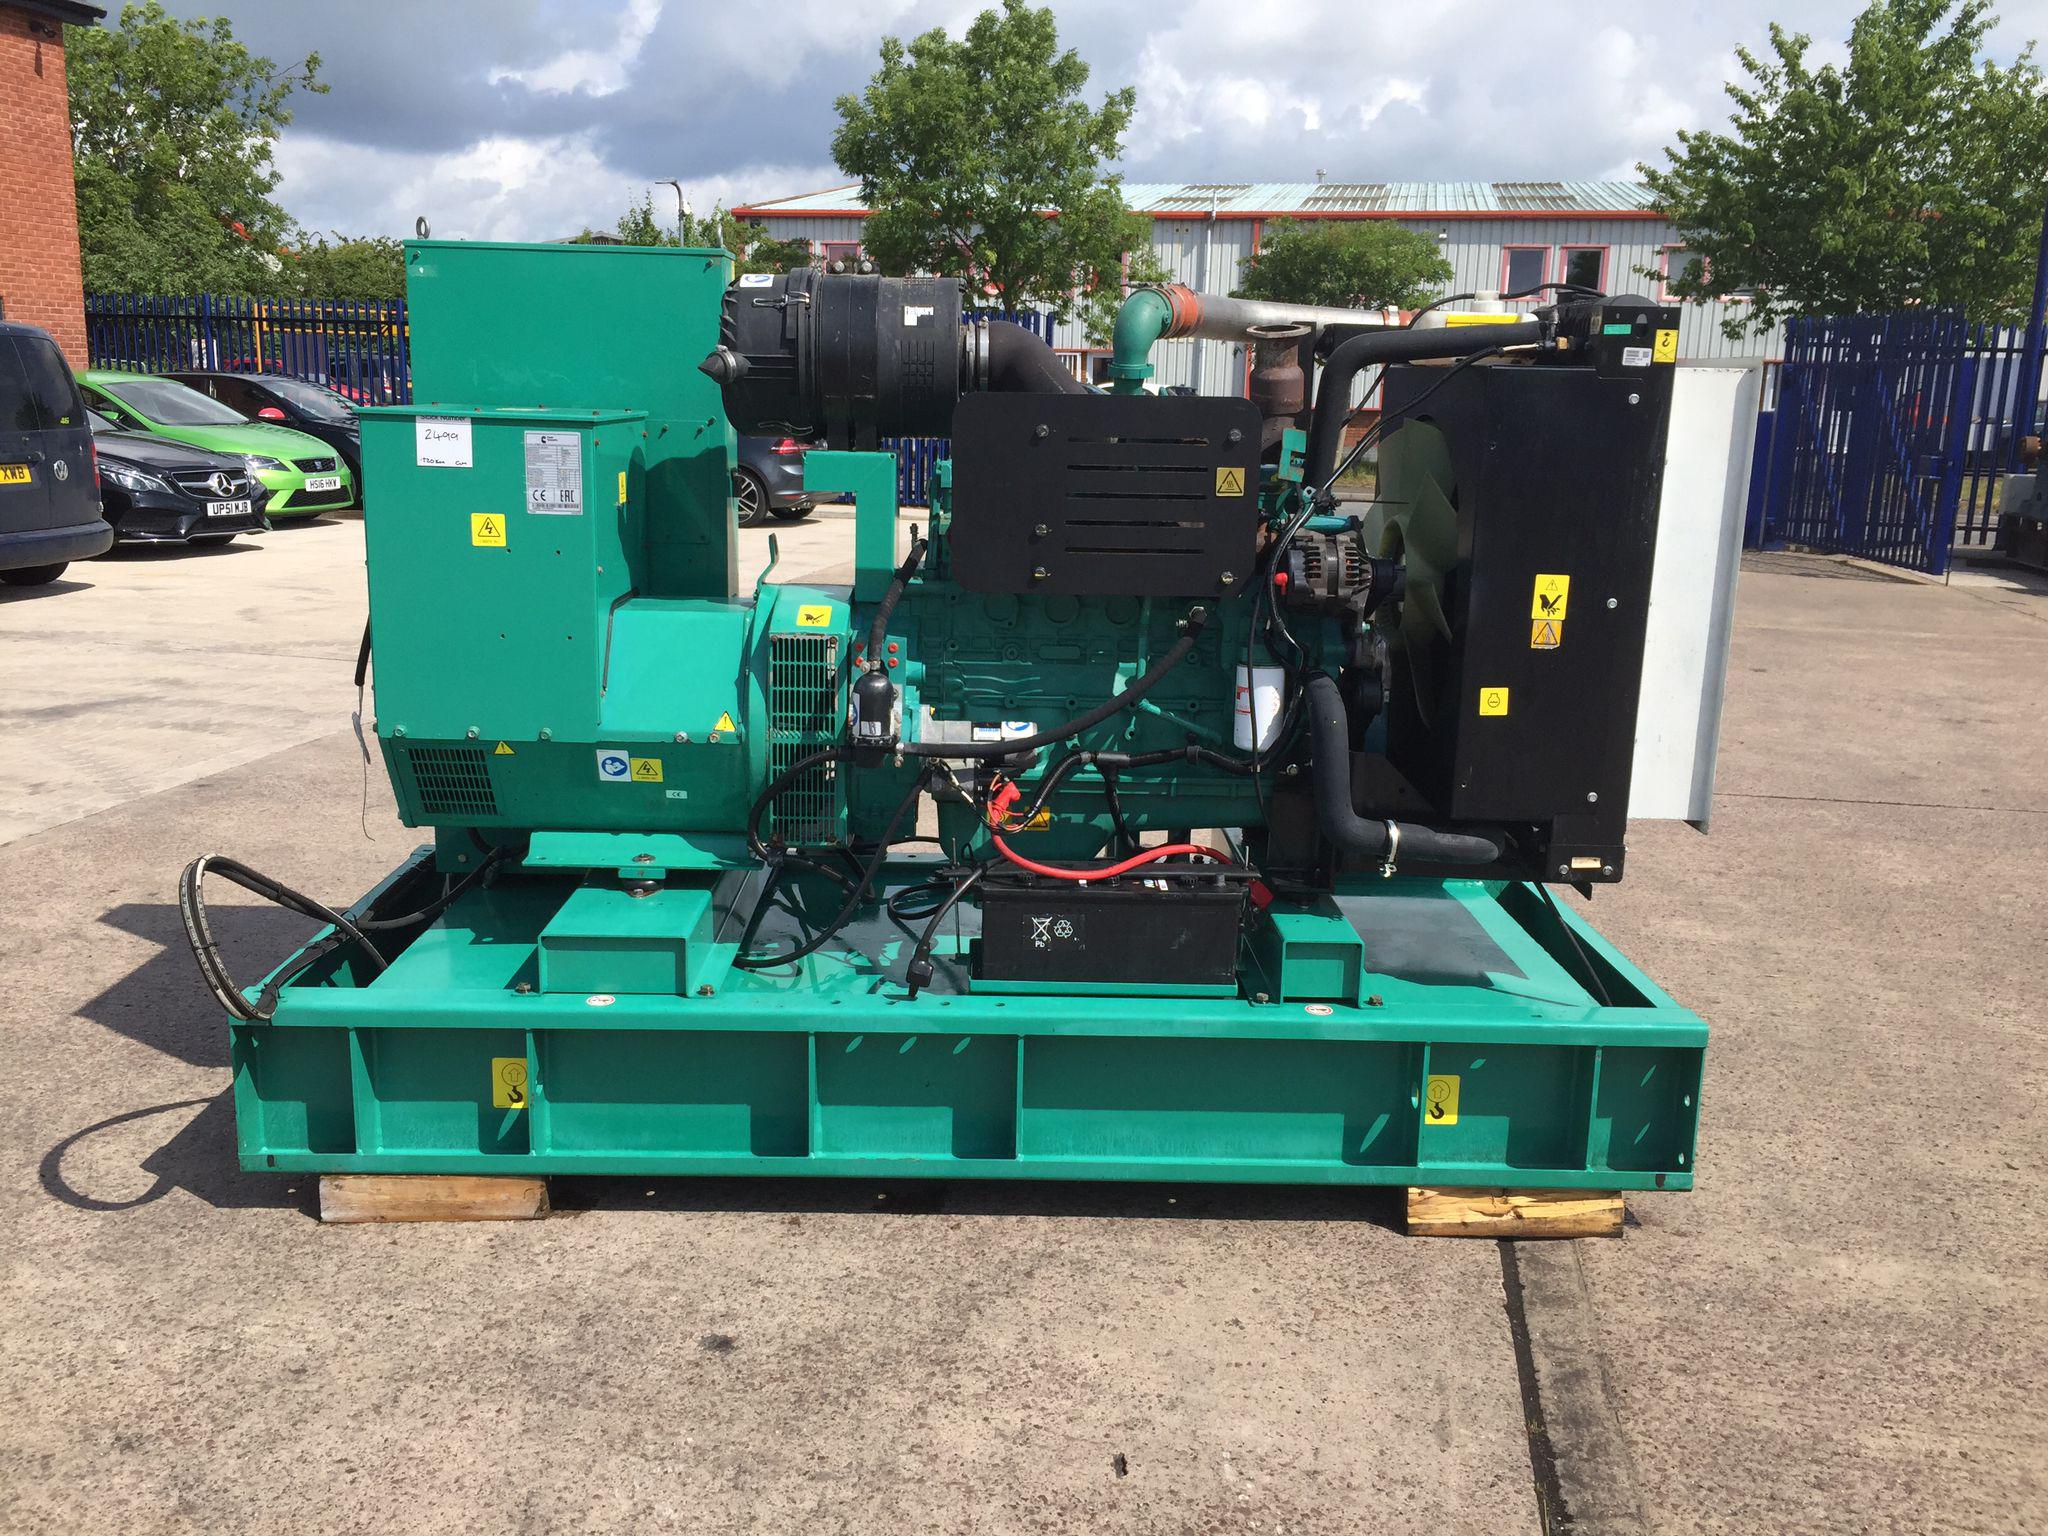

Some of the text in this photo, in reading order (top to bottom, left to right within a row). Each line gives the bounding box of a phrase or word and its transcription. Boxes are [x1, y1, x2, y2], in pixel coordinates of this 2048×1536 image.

[425, 428, 459, 442] 2499
[3, 465, 26, 480] XWB
[532, 490, 575, 502] CE EAC
[1035, 940, 1046, 948] Pb
